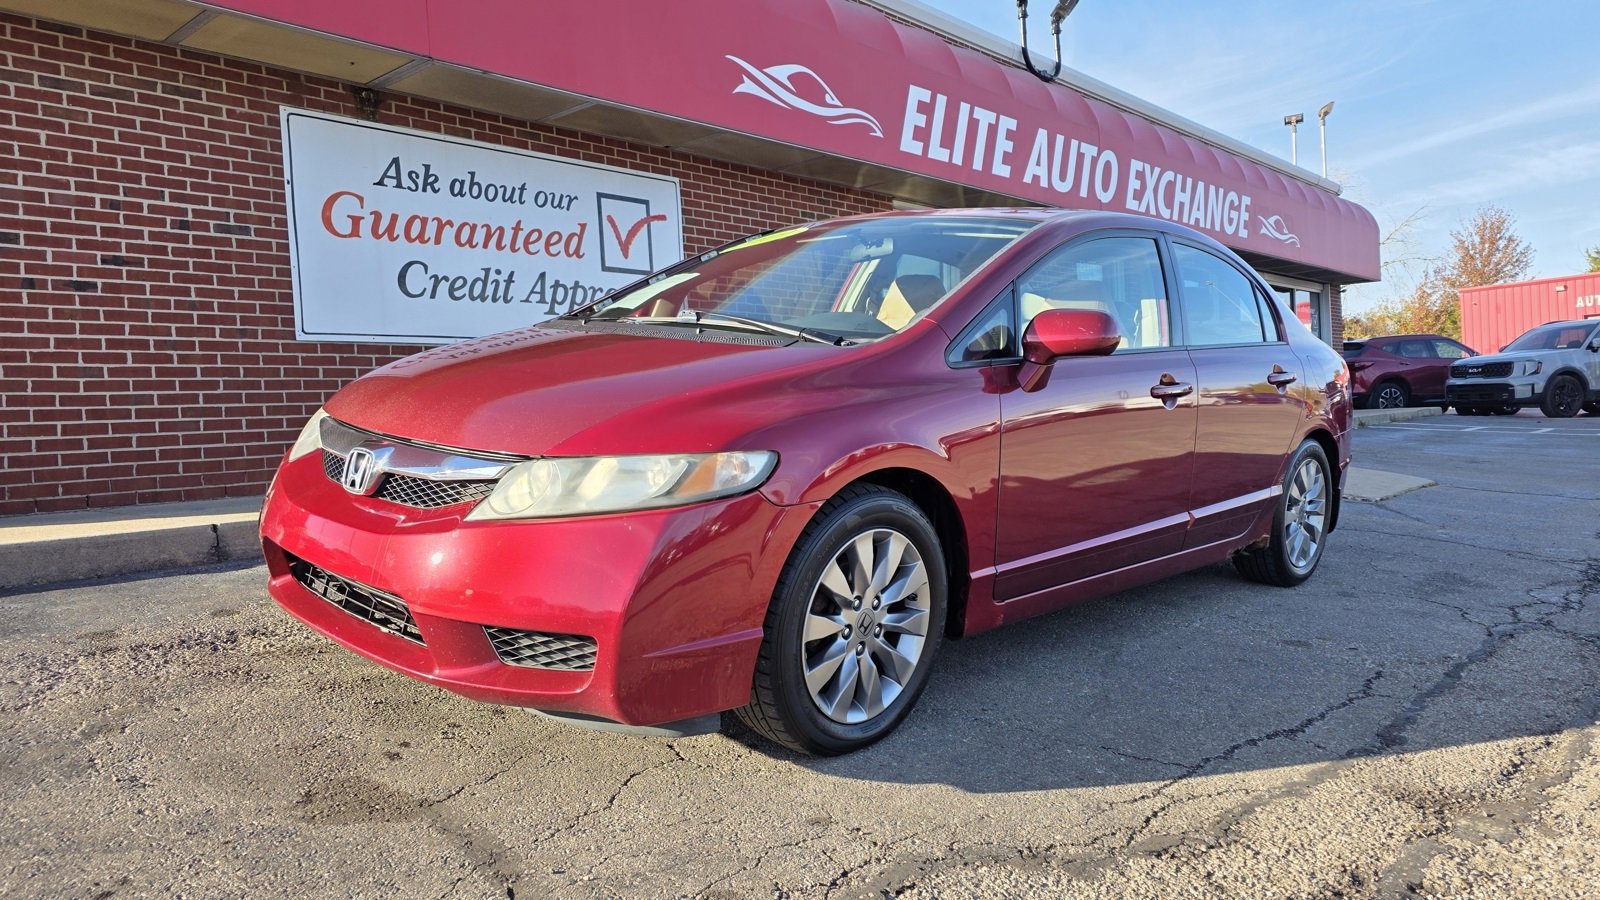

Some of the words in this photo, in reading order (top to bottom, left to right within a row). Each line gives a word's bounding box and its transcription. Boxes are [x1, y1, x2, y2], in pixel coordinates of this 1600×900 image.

[373, 156, 441, 194] Ask
[449, 171, 528, 206] about
[534, 190, 579, 212] our
[900, 84, 1017, 178] ELITE
[1023, 127, 1119, 204] AUTO
[1126, 158, 1251, 239] EXCHANGE
[321, 190, 587, 260] Guaranteed
[398, 260, 515, 304] Credit
